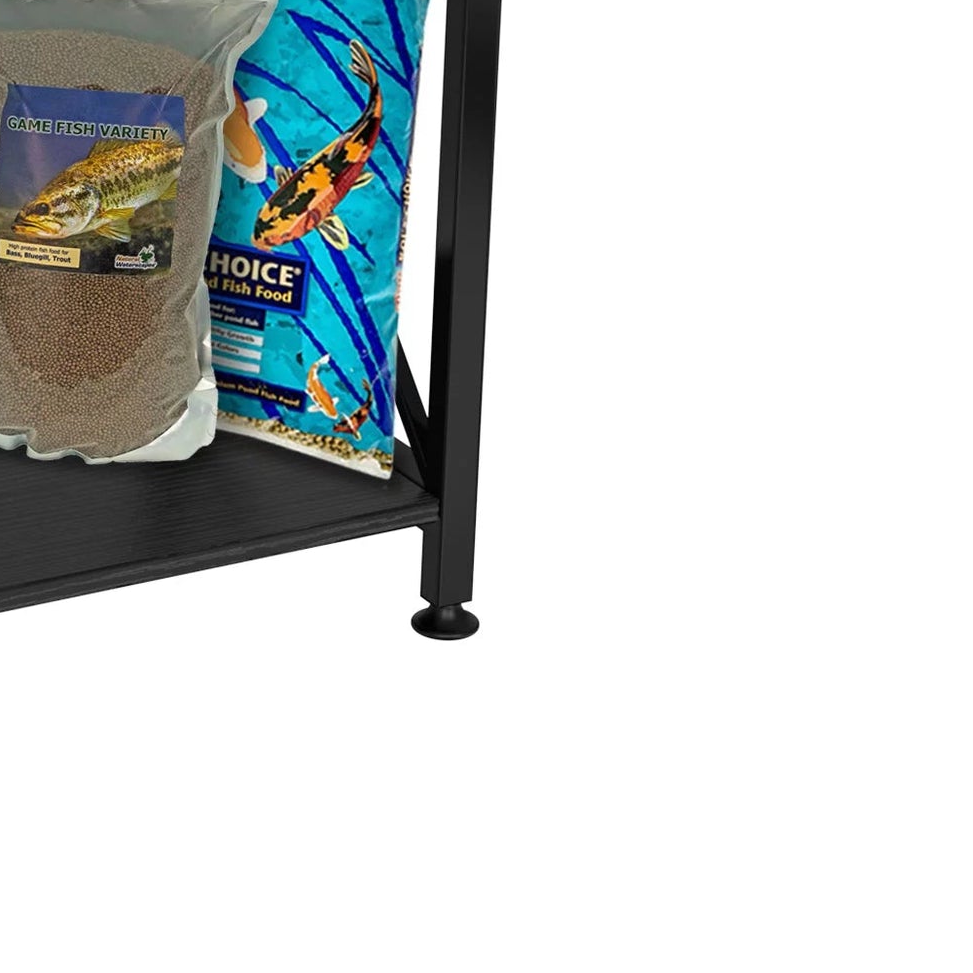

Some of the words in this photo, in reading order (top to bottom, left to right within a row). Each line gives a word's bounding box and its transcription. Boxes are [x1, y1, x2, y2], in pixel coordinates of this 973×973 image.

[7, 116, 50, 133] GAME
[55, 121, 95, 136] FISH
[100, 124, 169, 140] VARIETY
[6, 249, 22, 258] Bass,
[24, 252, 51, 261] Bluegill,
[53, 255, 71, 263] Trout
[205, 251, 294, 287] HOICE
[222, 279, 251, 295] Fish
[255, 285, 292, 303] Food
[279, 396, 300, 406] Food
